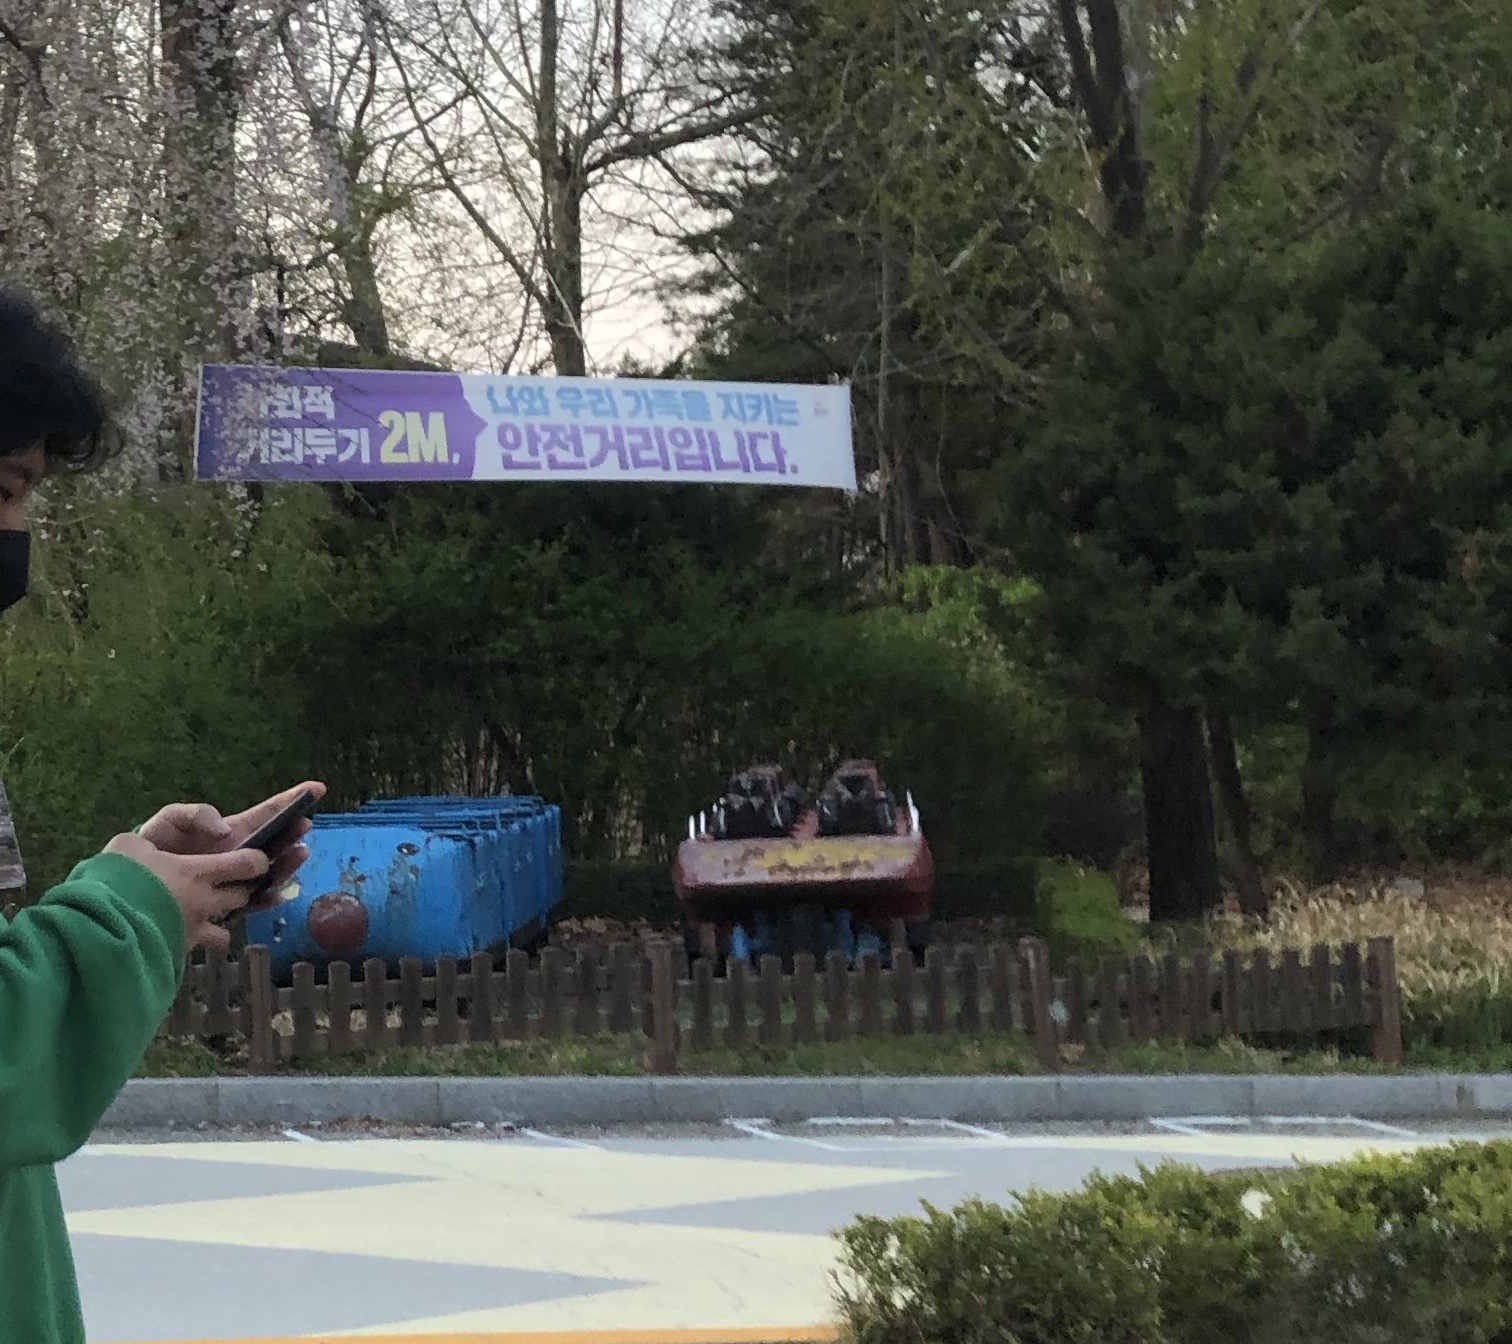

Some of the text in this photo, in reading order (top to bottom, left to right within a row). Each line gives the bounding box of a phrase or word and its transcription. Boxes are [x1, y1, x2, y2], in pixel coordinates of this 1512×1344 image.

[486, 384, 800, 426] 나와 우리 가족을 지키는
[496, 421, 800, 474] 안전거리입니다.
